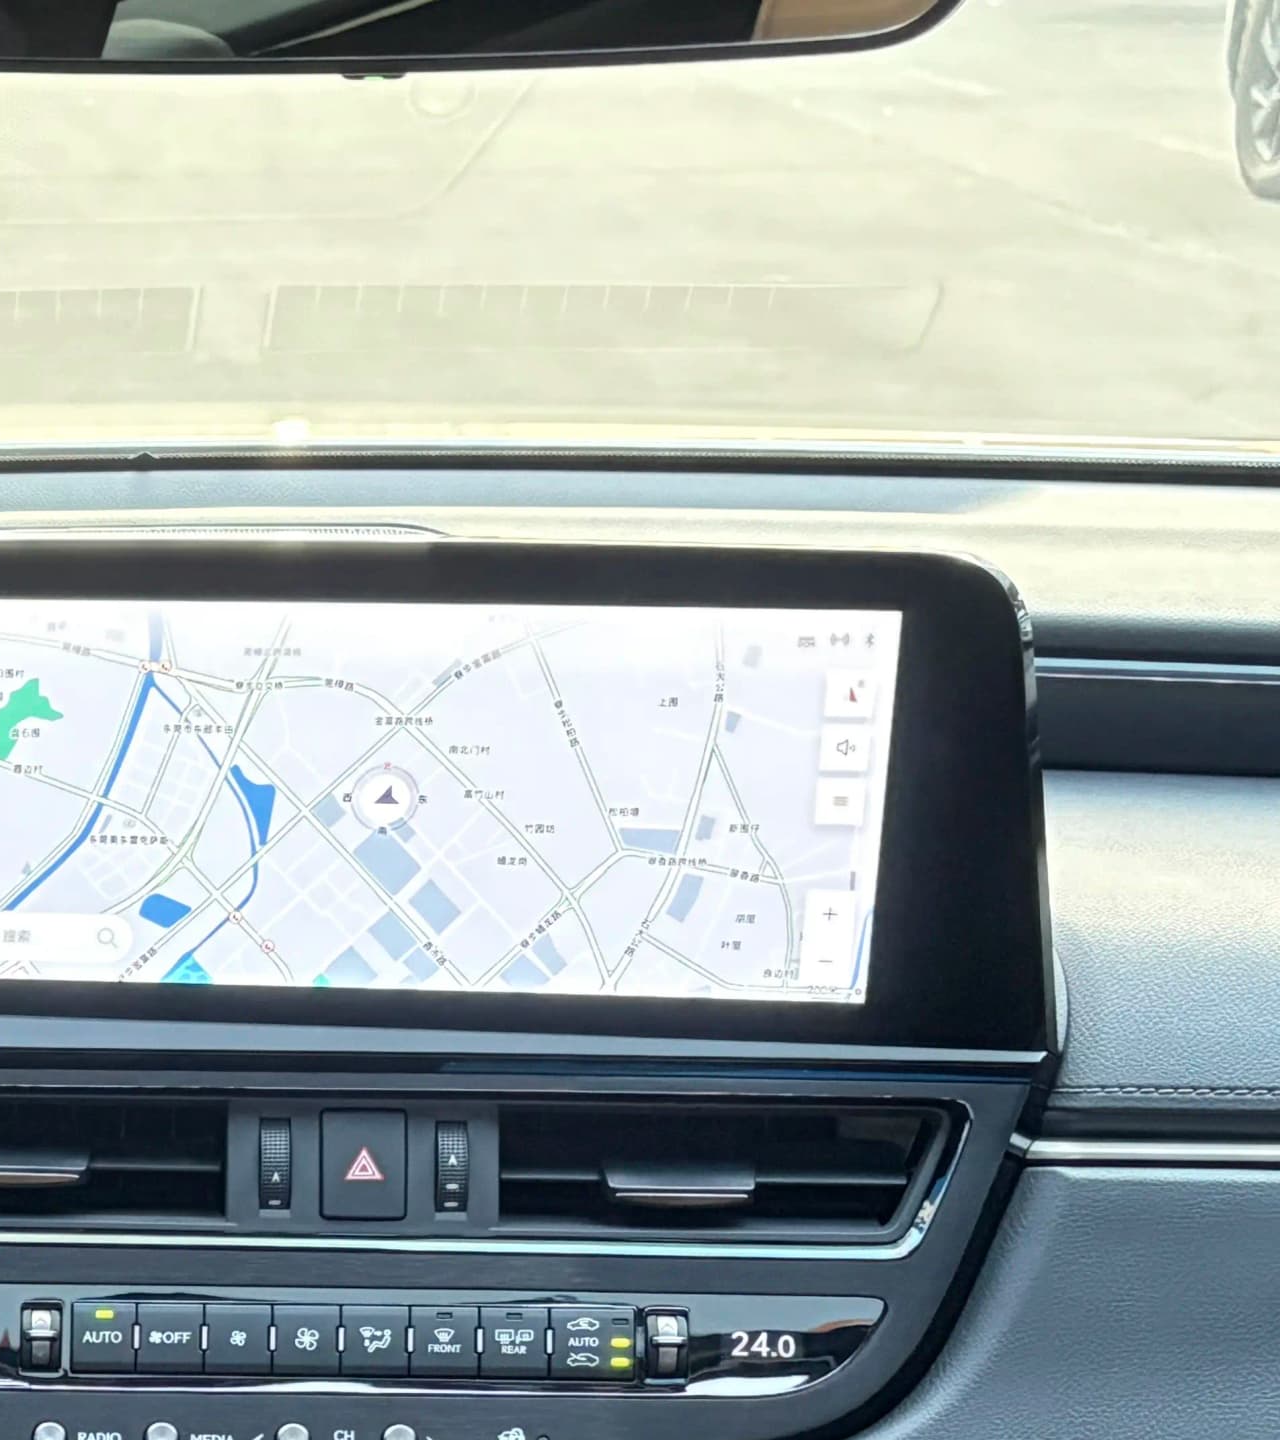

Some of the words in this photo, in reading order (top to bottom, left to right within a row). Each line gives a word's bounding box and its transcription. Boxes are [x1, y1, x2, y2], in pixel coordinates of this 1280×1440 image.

[2, 929, 31, 944] 搜索
[82, 1330, 123, 1345] AUTO
[163, 1331, 192, 1346] OFF
[567, 1335, 600, 1349] AUTO
[730, 1331, 797, 1359] 24.0
[427, 1342, 461, 1355] FRONT
[500, 1343, 527, 1356] REAR
